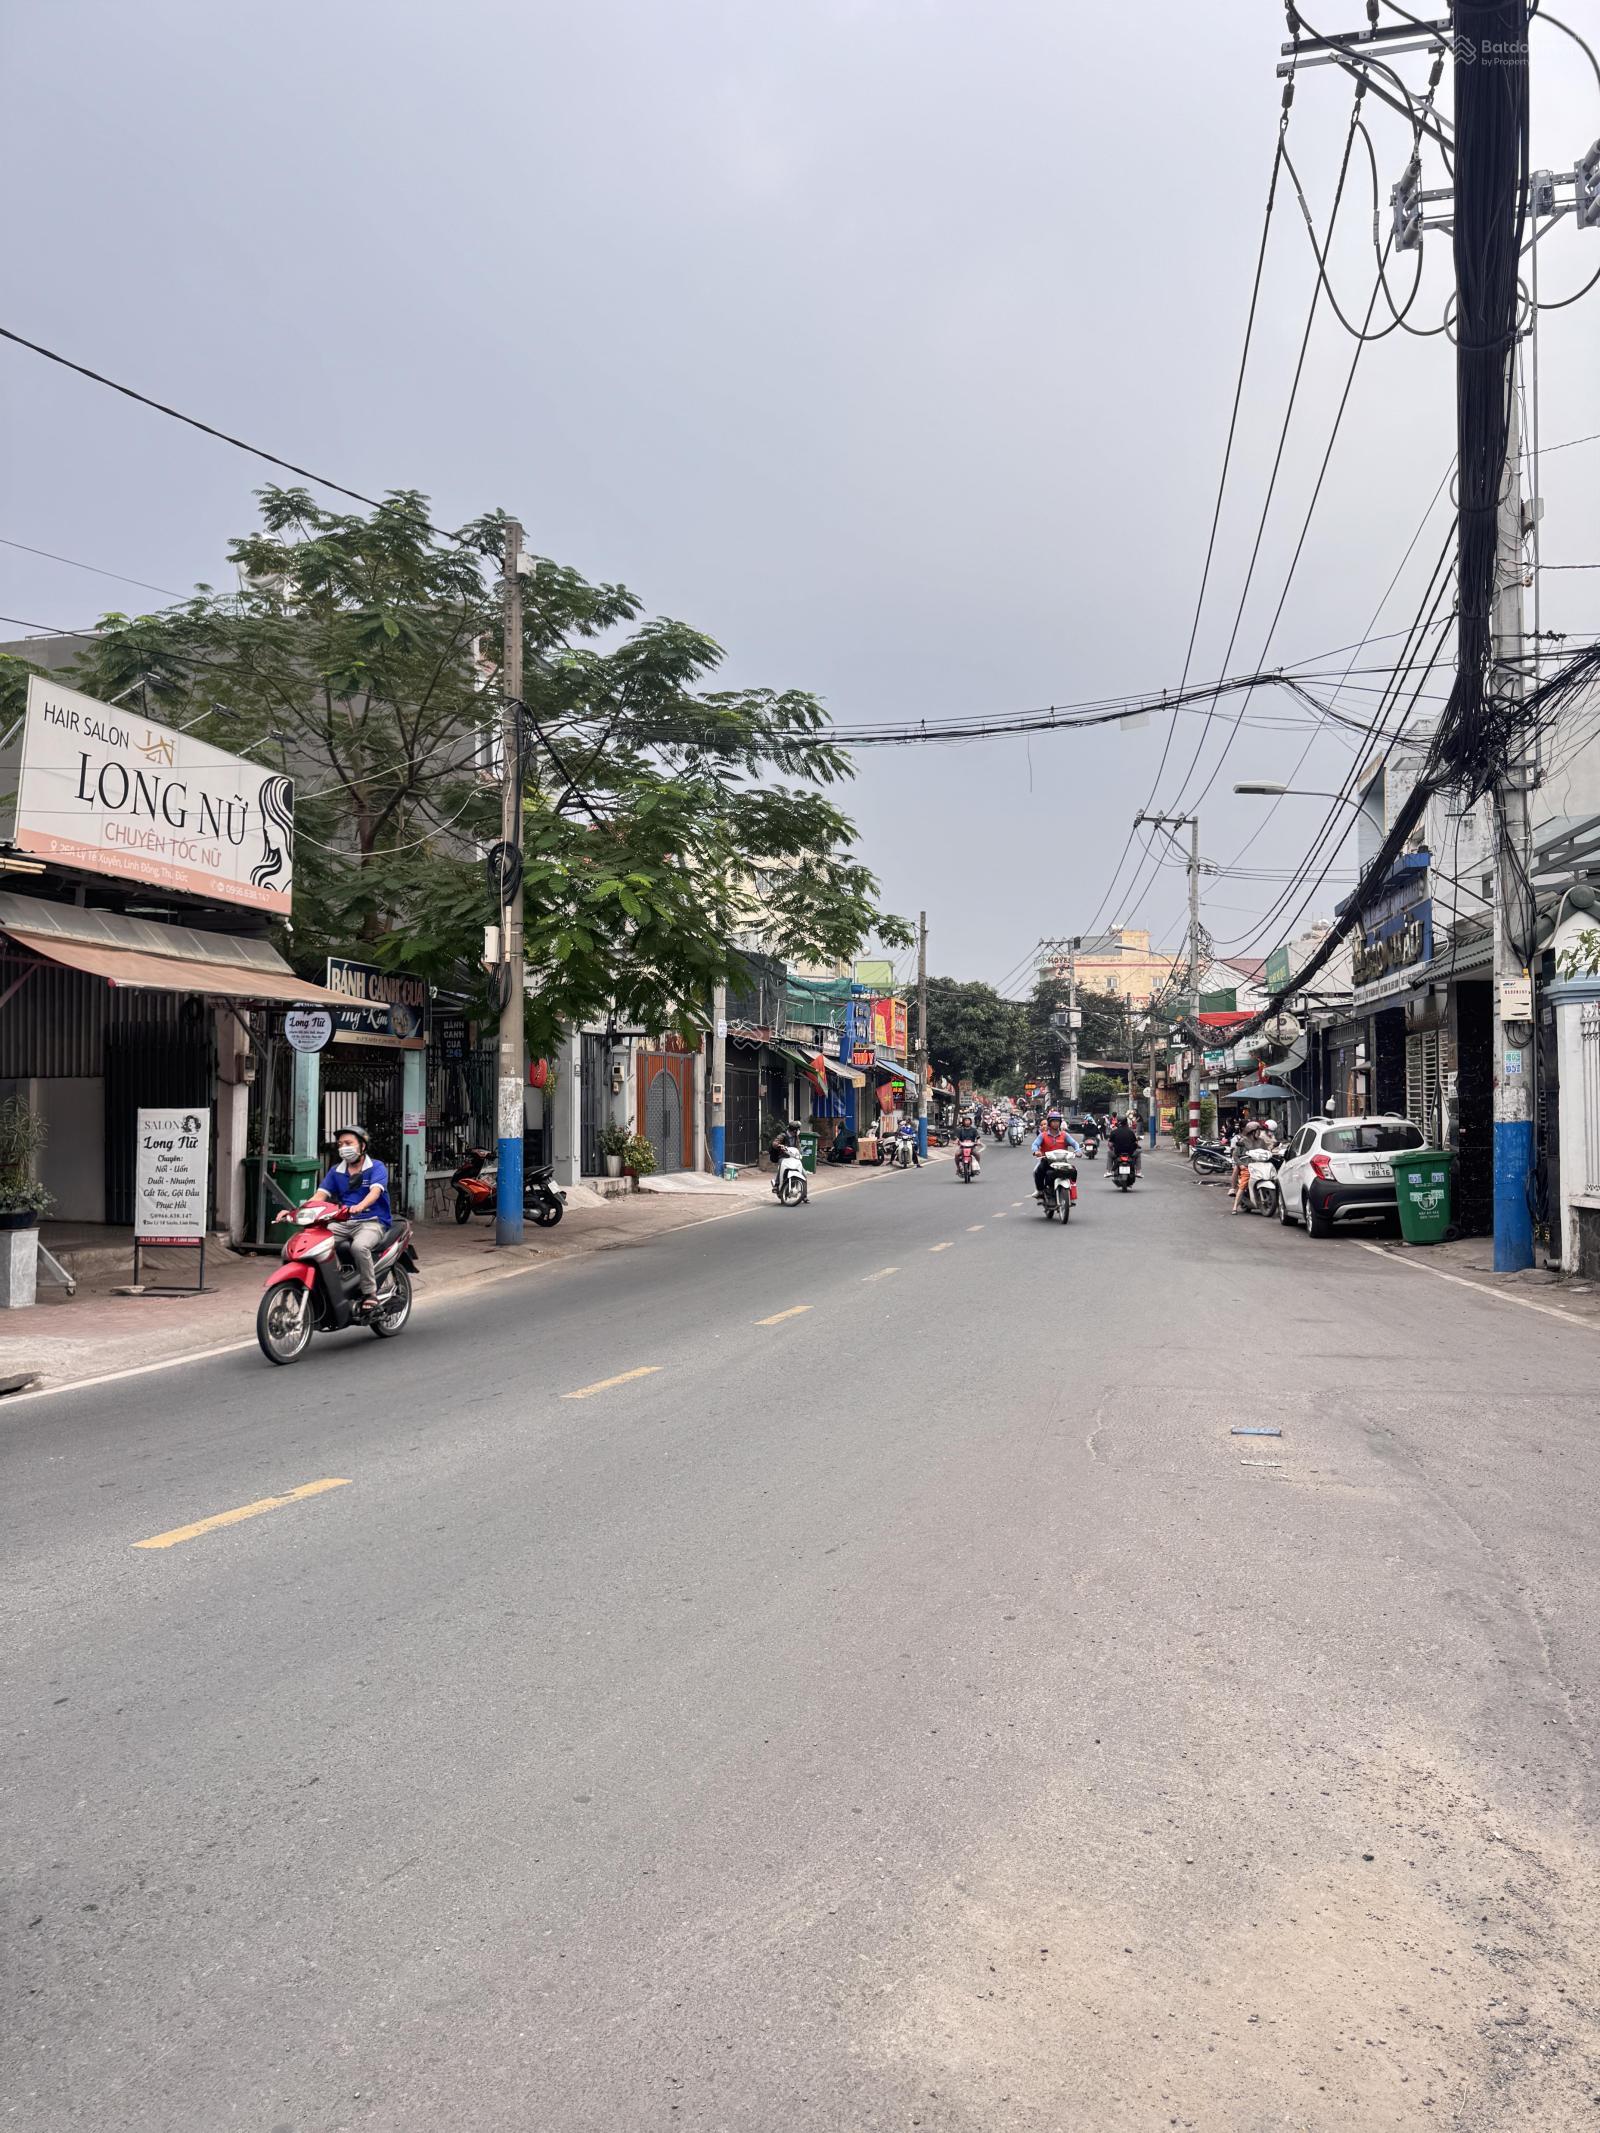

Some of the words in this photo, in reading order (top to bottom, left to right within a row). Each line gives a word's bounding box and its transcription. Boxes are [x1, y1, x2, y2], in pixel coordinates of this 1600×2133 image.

[44, 701, 79, 733] HAIR
[84, 717, 129, 750] SALON
[74, 751, 189, 828] LONG
[197, 793, 249, 846] NỮ
[105, 822, 165, 854] CHUYÊN
[169, 837, 198, 862] TÓC
[201, 848, 222, 868] NỮ
[332, 963, 366, 999] BÁNH
[369, 974, 400, 1003] CANH
[289, 1016, 310, 1029] Long
[312, 1016, 326, 1028] Nữ
[144, 1120, 181, 1130] SALON
[144, 1136, 174, 1152] Long
[178, 1136, 199, 1149] Nữ
